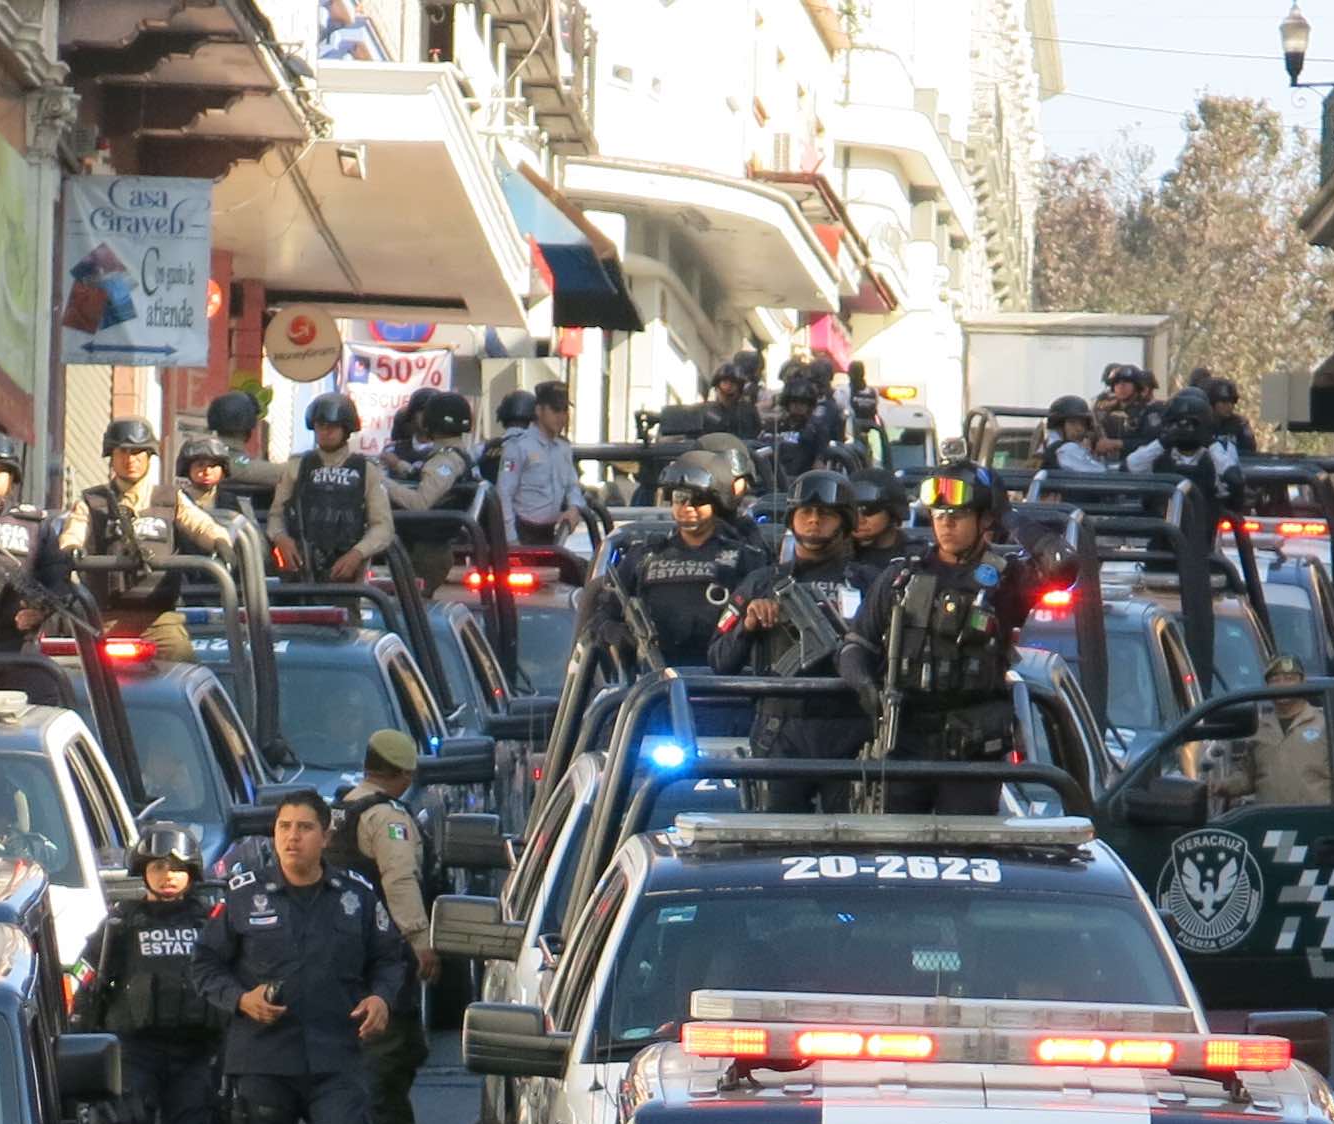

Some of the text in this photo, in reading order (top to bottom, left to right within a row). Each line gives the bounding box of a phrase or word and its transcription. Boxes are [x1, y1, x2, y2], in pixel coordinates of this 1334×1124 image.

[108, 176, 168, 212] Casa
[147, 300, 195, 328] atiende
[376, 355, 442, 387] 50%
[1177, 835, 1243, 853] VERACRUZ
[781, 855, 1002, 883] 20-2623
[138, 928, 198, 942] POLICI
[1176, 931, 1217, 949] FUERZA
[140, 941, 194, 956] ESTAT
